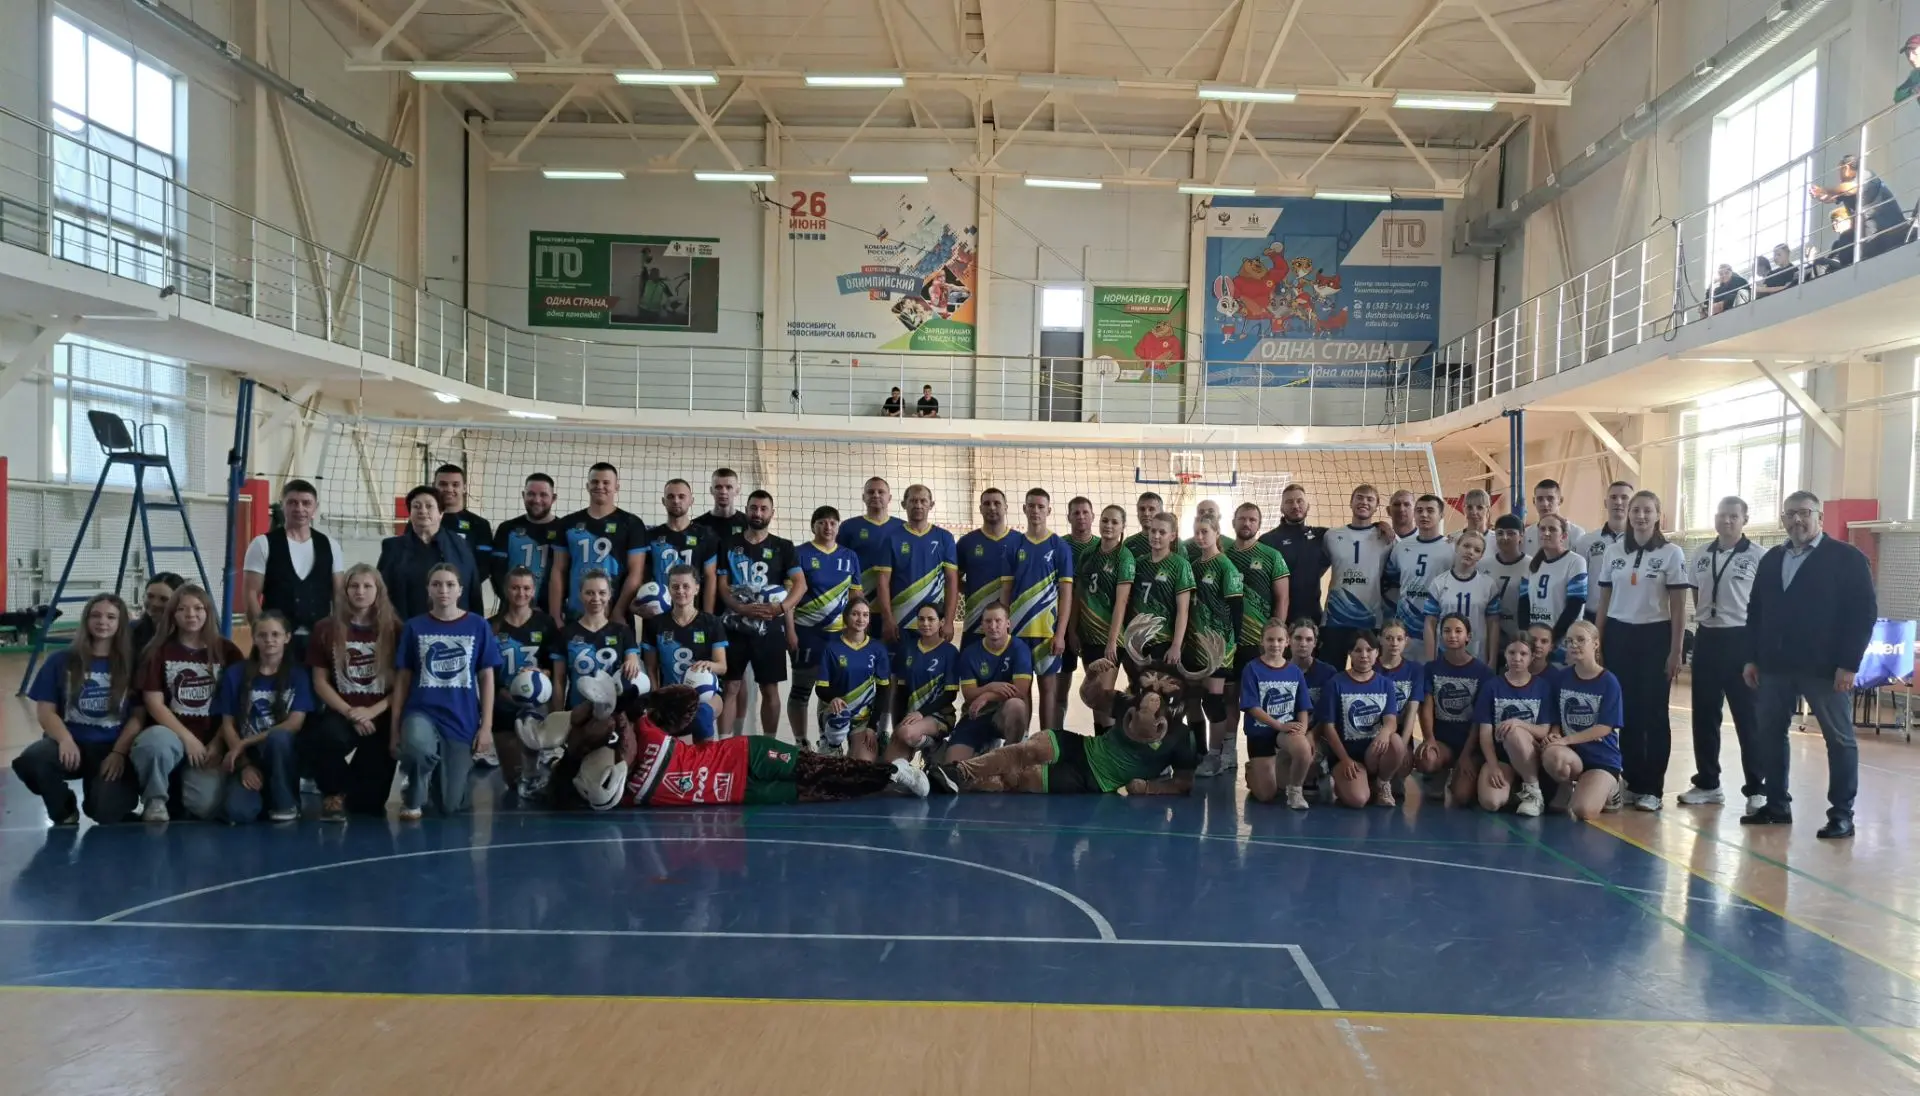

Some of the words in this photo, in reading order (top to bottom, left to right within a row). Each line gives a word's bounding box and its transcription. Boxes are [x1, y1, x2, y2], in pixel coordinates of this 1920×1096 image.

[791, 191, 826, 217] 26
[789, 219, 826, 230] ИЮНЯ
[1382, 218, 1426, 248] ГТО
[536, 245, 582, 278] ГТО
[846, 275, 915, 292] ОЛИМПИЙСКИЙ
[545, 296, 571, 306] ОДНА
[572, 297, 608, 309] СТРАНА,
[1103, 293, 1151, 303] НОРМАТИВ
[546, 309, 564, 317] одна
[787, 330, 845, 338] НОВОСИБИРСКАЯ
[1261, 341, 1316, 361] ОДНА
[521, 544, 549, 567] 11
[578, 537, 612, 562] 19
[931, 541, 939, 554] 7
[1044, 549, 1054, 562] 4
[1353, 541, 1360, 564] 1
[662, 549, 692, 574] 21
[837, 558, 851, 572] 11
[1416, 554, 1428, 577] 5
[737, 561, 768, 588] 18
[1089, 573, 1098, 593] 3
[1141, 582, 1152, 603] 7
[1500, 576, 1511, 600] 7
[1537, 574, 1550, 599] 9
[1456, 592, 1470, 617] 11
[502, 646, 540, 674] 13
[574, 648, 617, 674] 69
[673, 647, 694, 675] 8
[868, 655, 875, 668] 3
[927, 659, 938, 671] 2
[1001, 657, 1010, 672] 5
